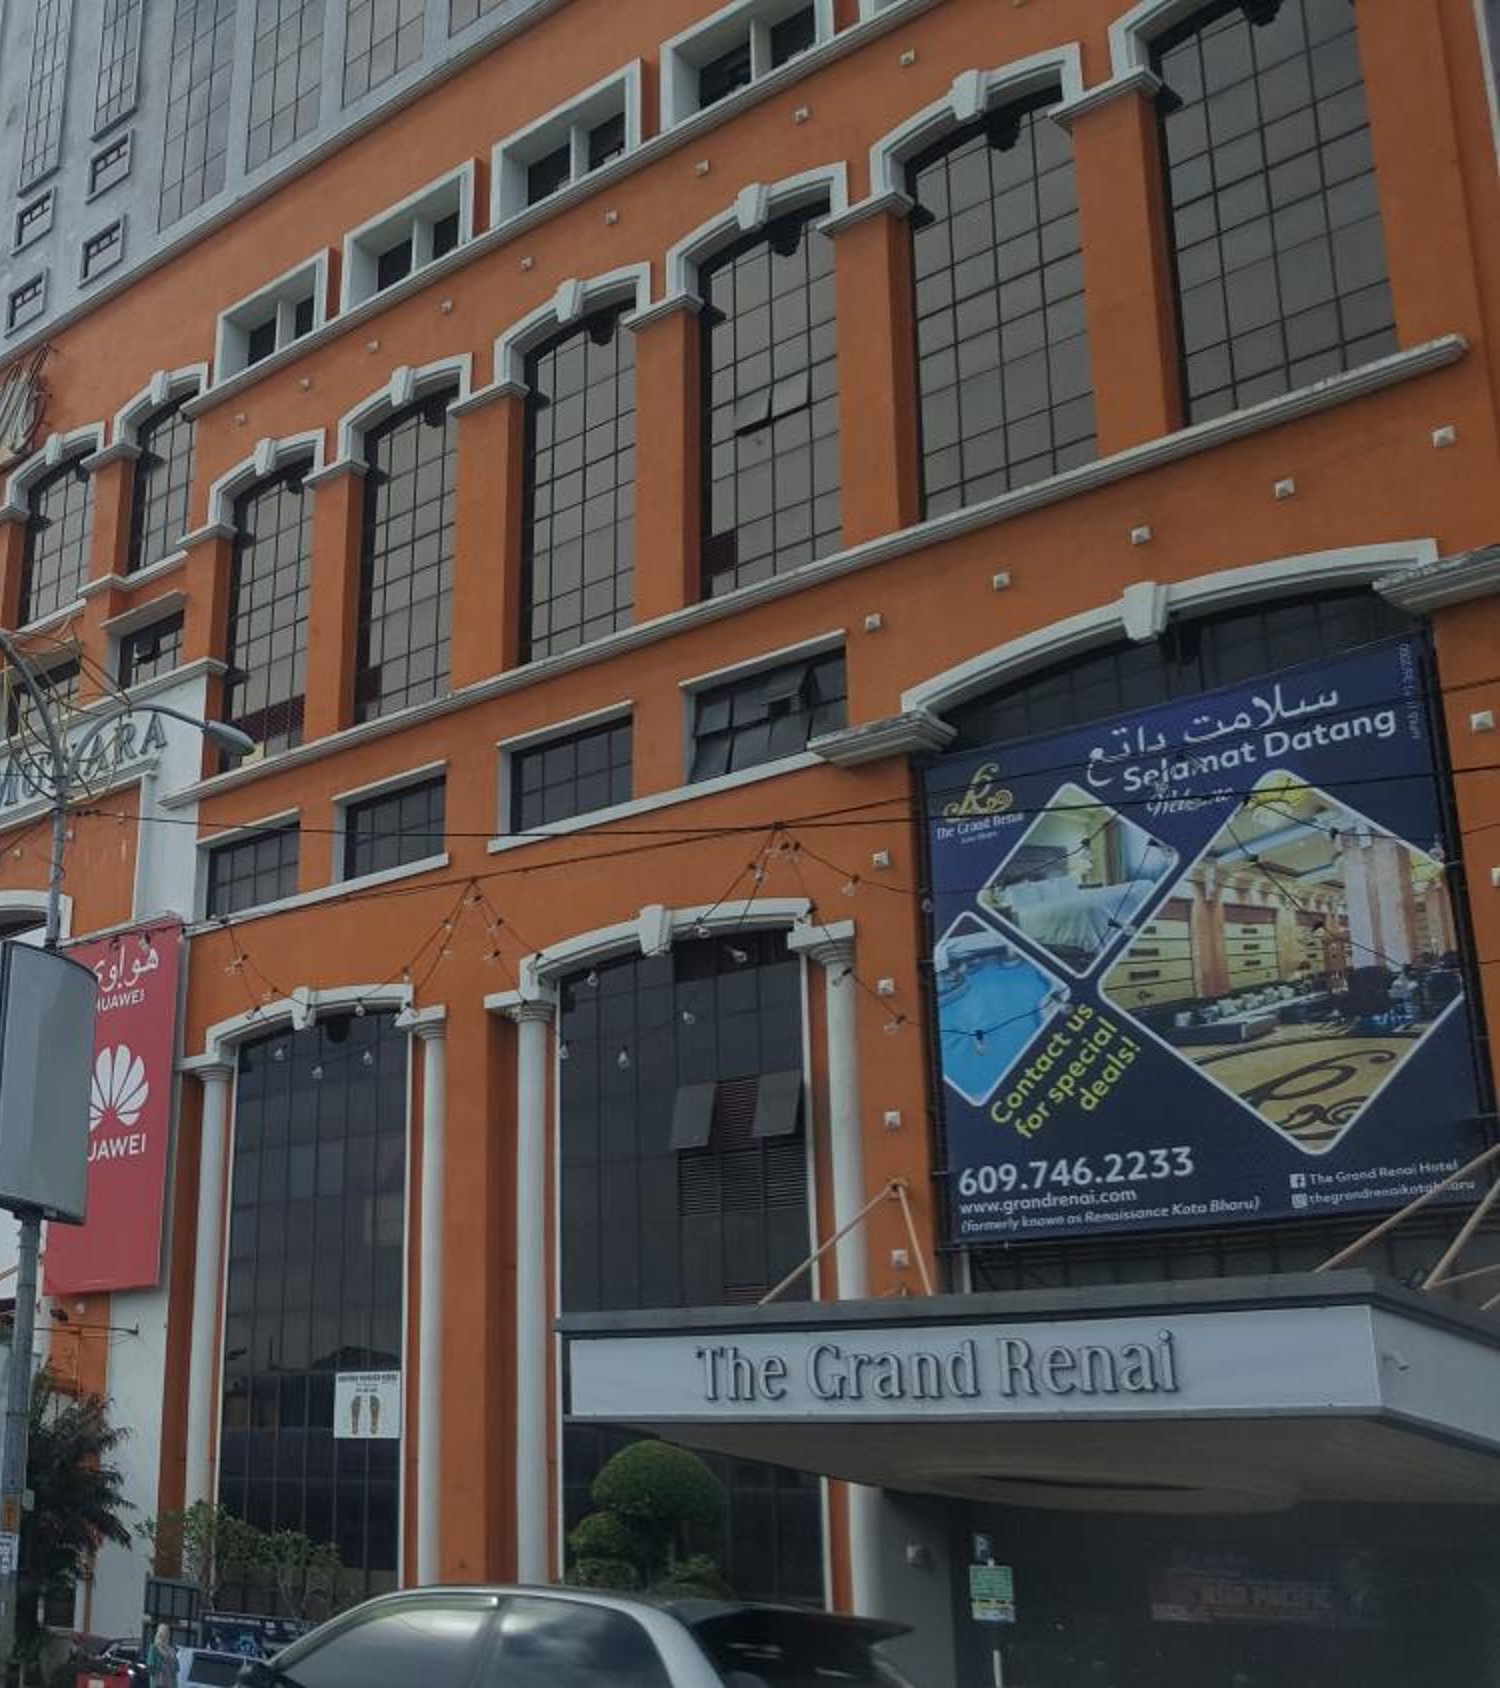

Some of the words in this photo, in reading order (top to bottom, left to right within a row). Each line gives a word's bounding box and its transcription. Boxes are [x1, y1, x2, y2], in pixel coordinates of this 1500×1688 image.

[1123, 742, 1256, 792] Selamat
[1264, 709, 1396, 758] Datang
[991, 1032, 1072, 1123] Contact
[1066, 1004, 1094, 1032] us
[1015, 1102, 1050, 1139] for
[1048, 1016, 1118, 1104] special
[1079, 1036, 1141, 1111] deals!
[87, 1133, 147, 1162] UAWEI
[959, 1146, 1195, 1196] 609.746.2233
[1336, 1168, 1377, 1183] Grand
[960, 1189, 1138, 1216] www.grandrenai.com
[961, 1213, 1019, 1234] (formerly
[1067, 1213, 1082, 1224] as
[1084, 1203, 1169, 1223] Renaissance
[1171, 1201, 1208, 1216] Kota
[1209, 1195, 1261, 1214] Bharu)
[696, 1346, 788, 1402] The
[806, 1340, 982, 1400] Grand
[997, 1329, 1180, 1397] Renai
